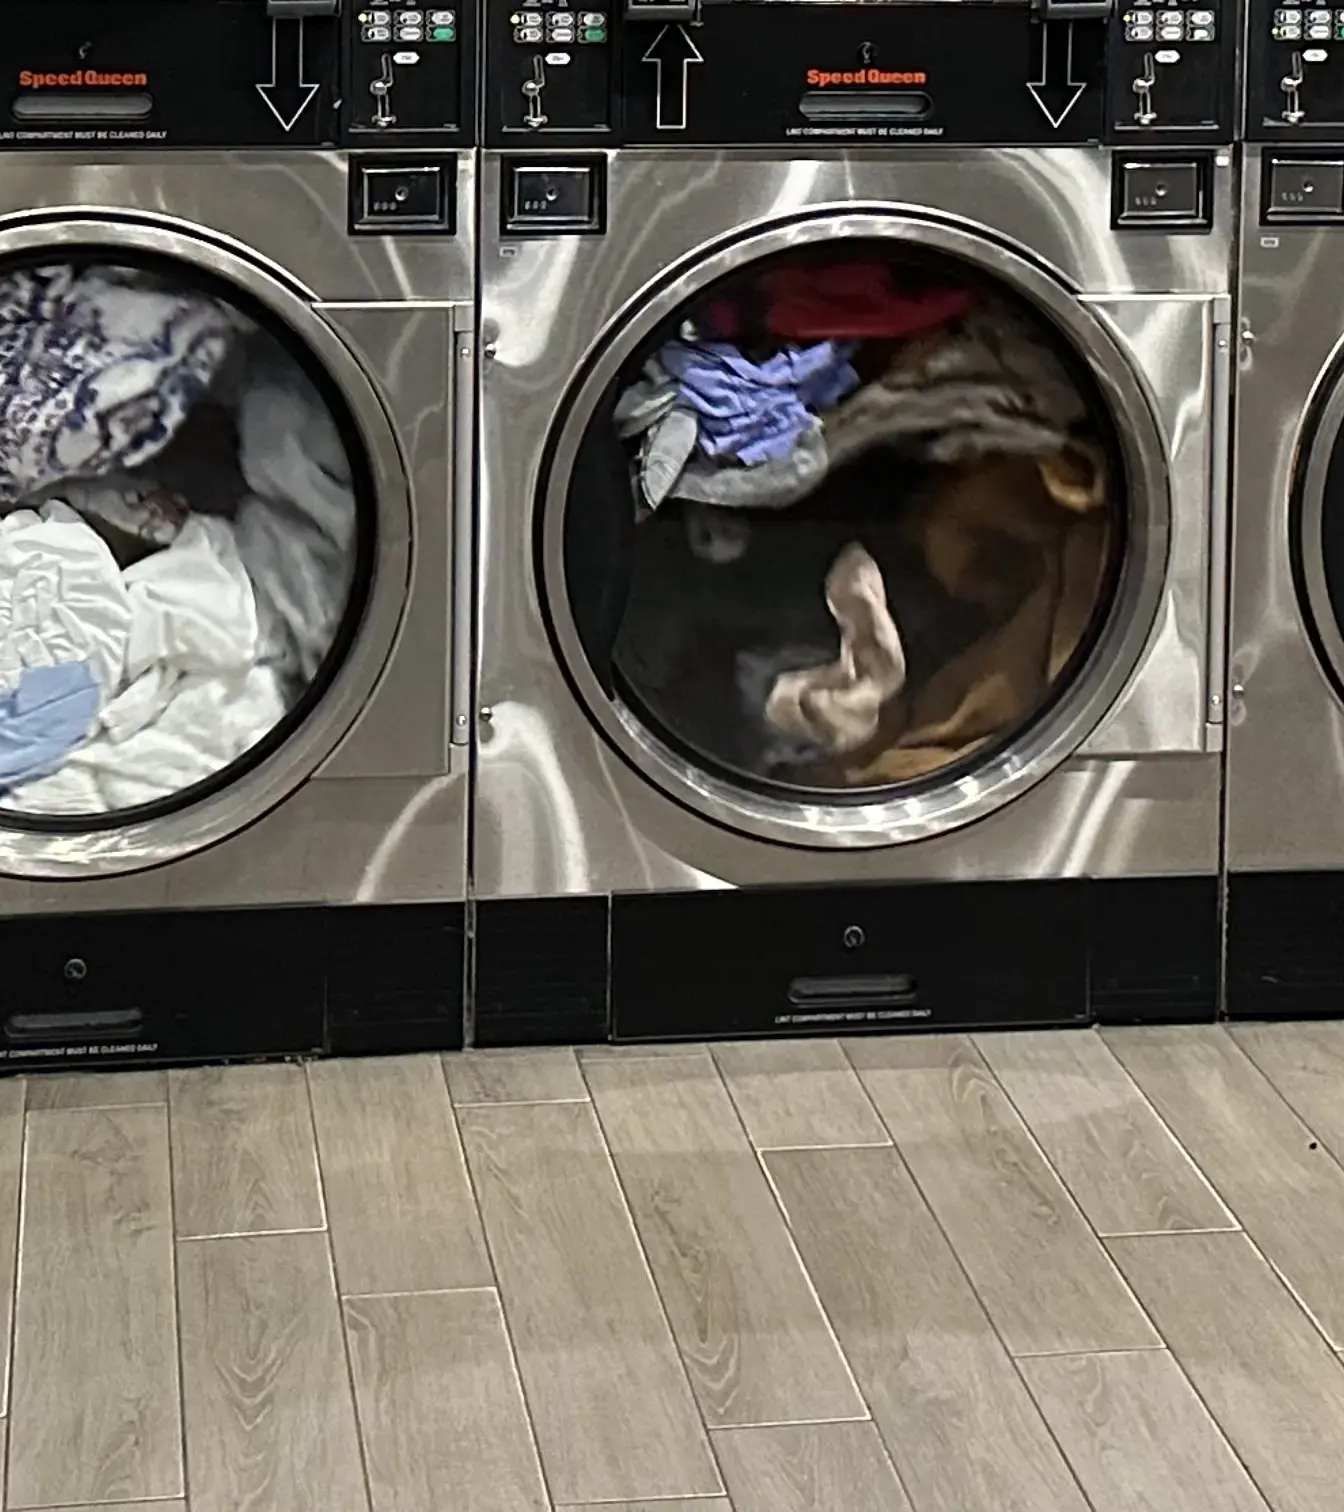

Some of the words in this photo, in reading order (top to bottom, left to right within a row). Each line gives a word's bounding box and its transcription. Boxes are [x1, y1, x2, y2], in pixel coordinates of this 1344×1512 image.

[19, 70, 81, 88] Speed
[84, 70, 147, 85] Queen
[807, 69, 865, 87] Speed
[867, 69, 926, 84] Queen
